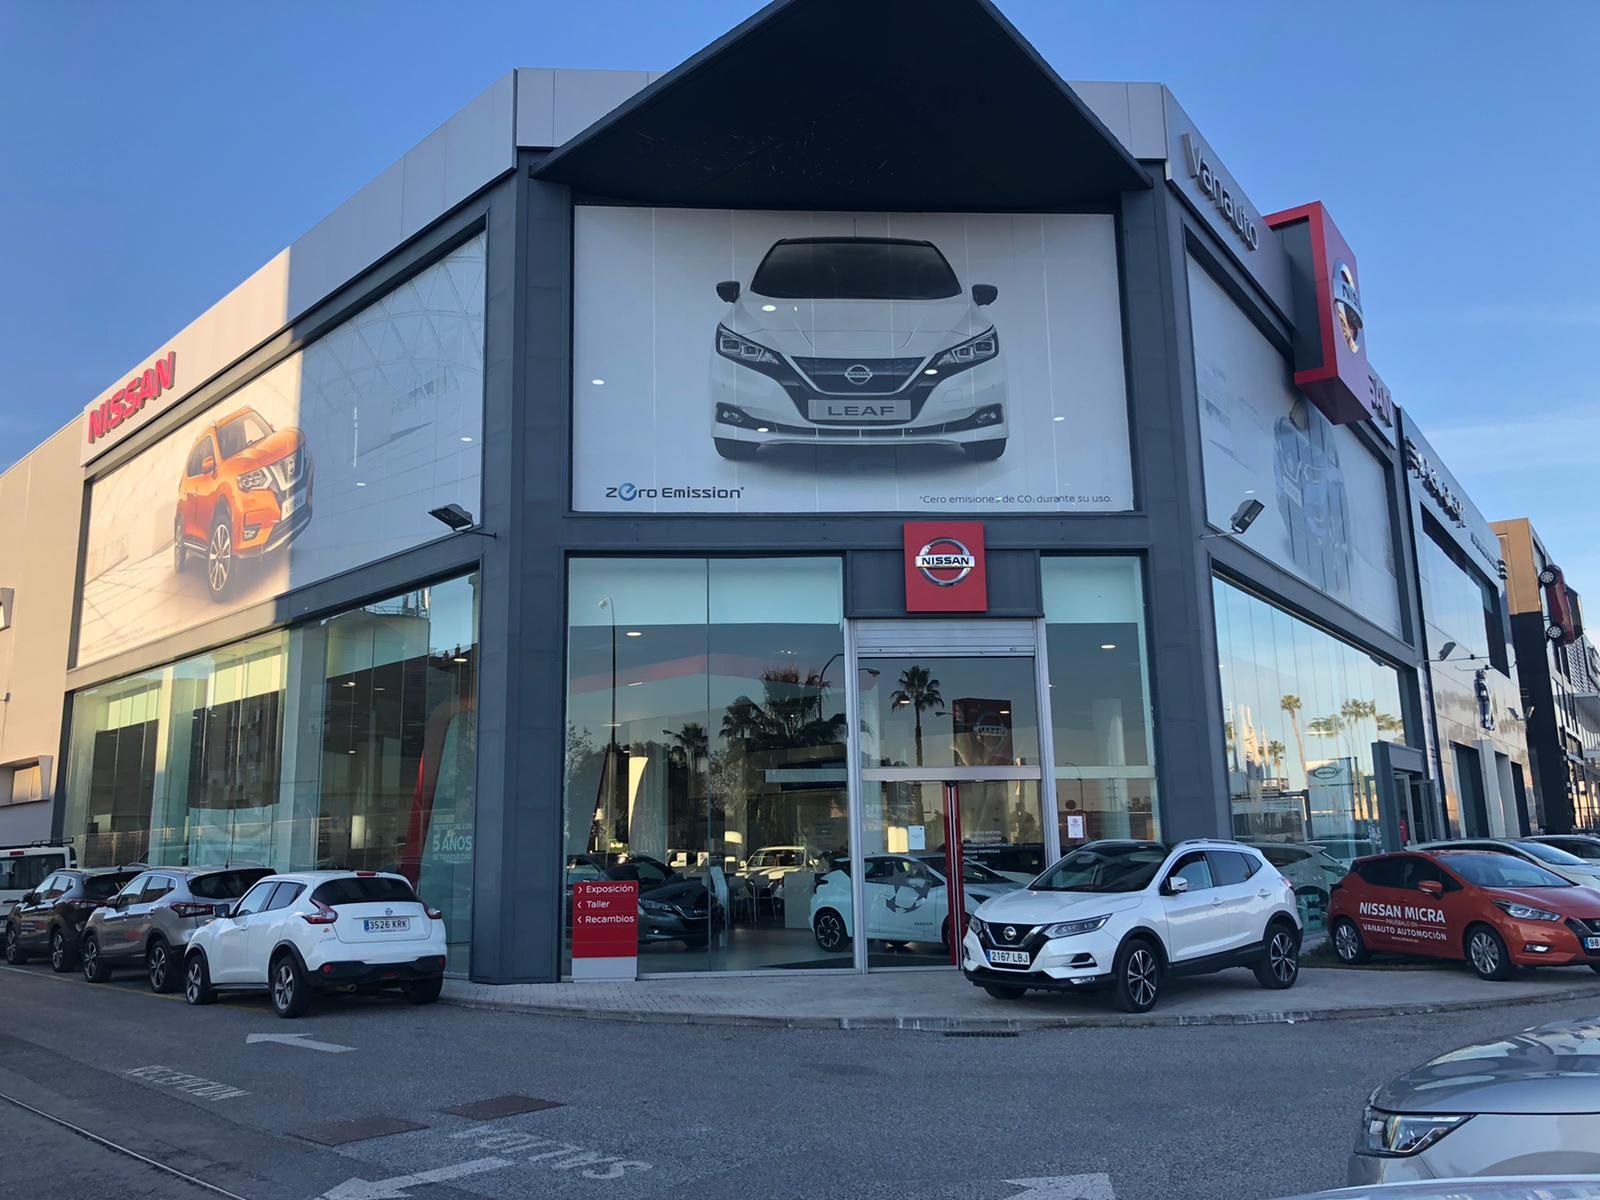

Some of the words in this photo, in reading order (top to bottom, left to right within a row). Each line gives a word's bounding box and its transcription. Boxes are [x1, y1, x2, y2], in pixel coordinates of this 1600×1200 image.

[1182, 133, 1259, 251] Vanauto
[88, 351, 176, 444] NISSAN
[827, 406, 895, 416] LEAF
[1002, 494, 1015, 503] de
[1037, 494, 1075, 504] durante
[1077, 494, 1090, 503] su
[1092, 494, 1113, 503] uso.
[921, 556, 970, 565] NISSAN
[432, 834, 441, 852] 5
[586, 884, 634, 895] Exposición
[586, 900, 610, 908] Taller
[1360, 902, 1402, 919] NISSAN
[1404, 906, 1446, 924] MICRA
[370, 920, 391, 930] 3526
[585, 915, 635, 924] Recambios
[1362, 922, 1396, 935] VANAUTO
[1397, 926, 1447, 941] AUTOMOCIÓN
[991, 951, 1011, 962] 2167
[1012, 952, 1029, 963] LBJ
